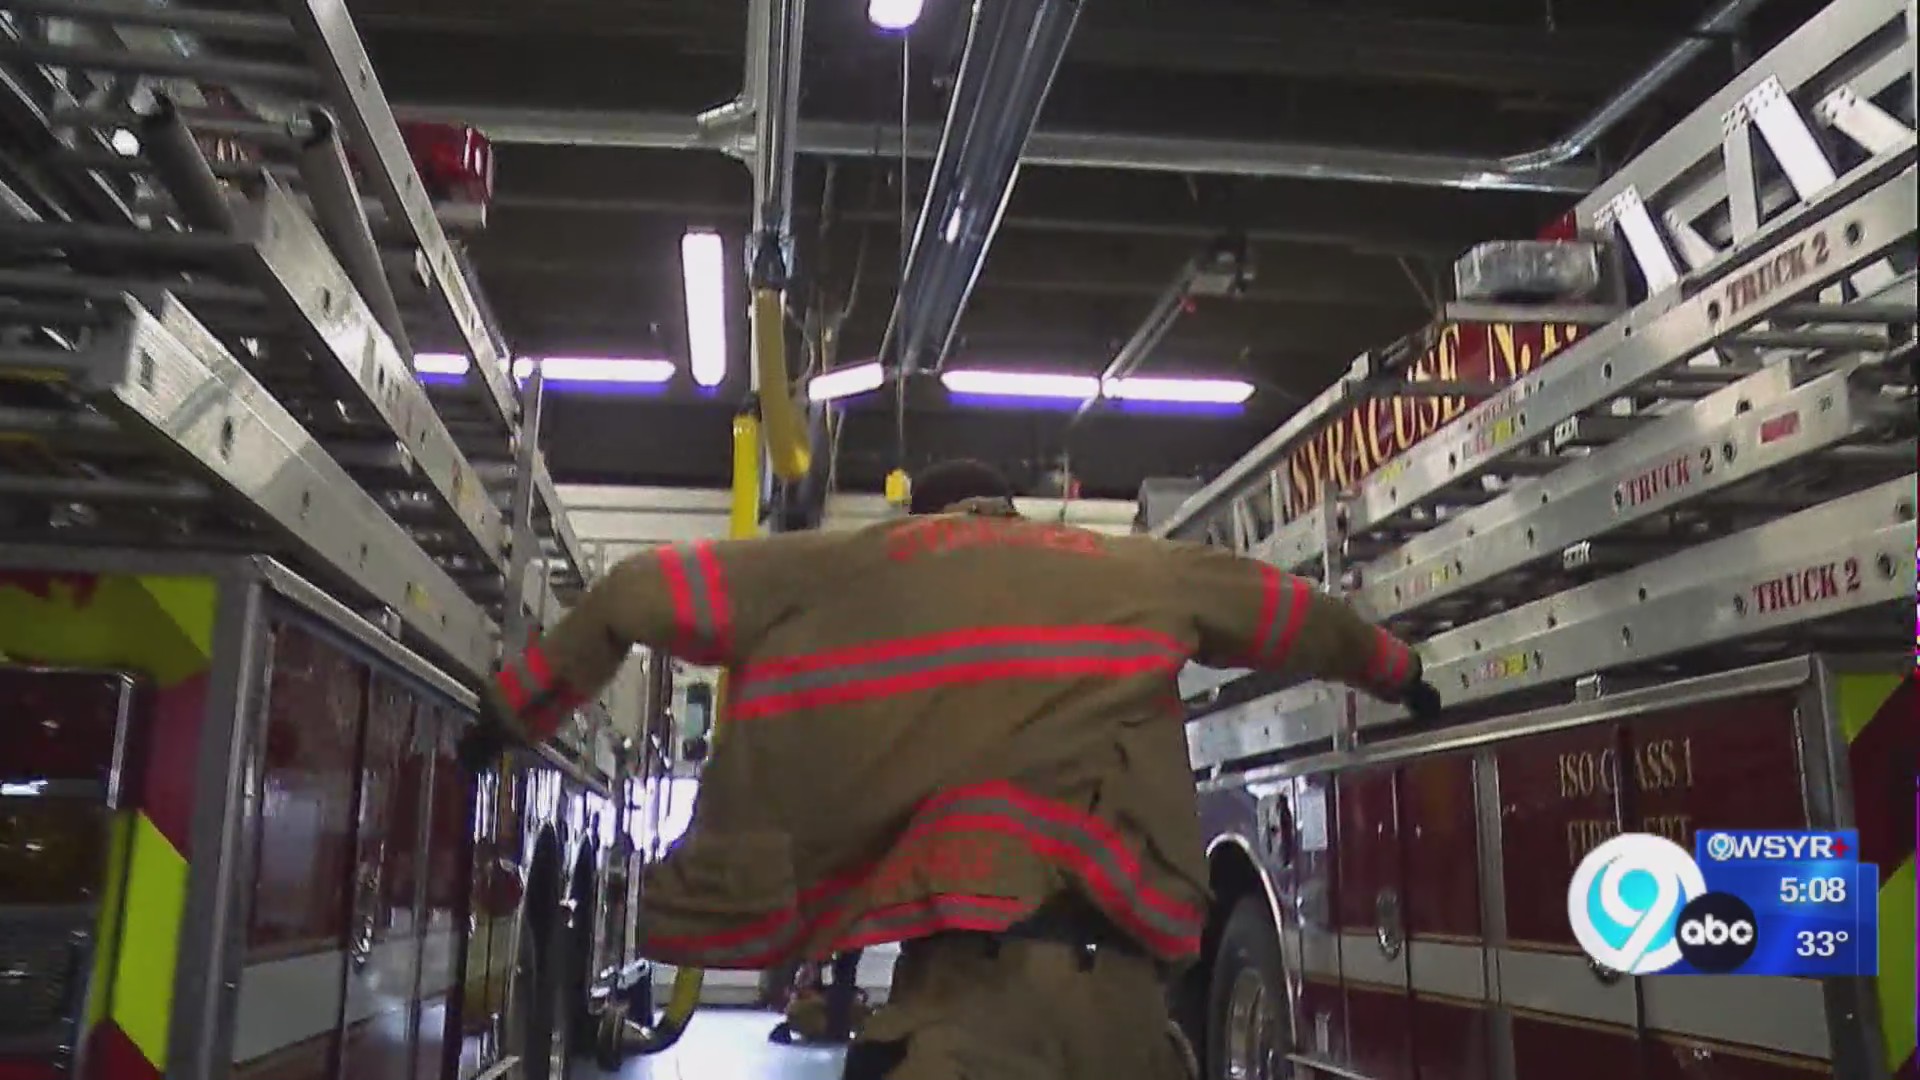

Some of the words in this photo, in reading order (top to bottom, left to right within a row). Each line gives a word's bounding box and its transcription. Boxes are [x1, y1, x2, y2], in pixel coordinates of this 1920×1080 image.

[1726, 242, 1807, 314] TRUCK
[1812, 231, 1830, 266] 2
[1625, 454, 1691, 506] TRUCK
[1700, 446, 1713, 475] 2
[1752, 561, 1839, 614] TRUCK
[1845, 556, 1862, 592] 2
[1559, 751, 1594, 797] ISO
[1600, 739, 1677, 793] CASS
